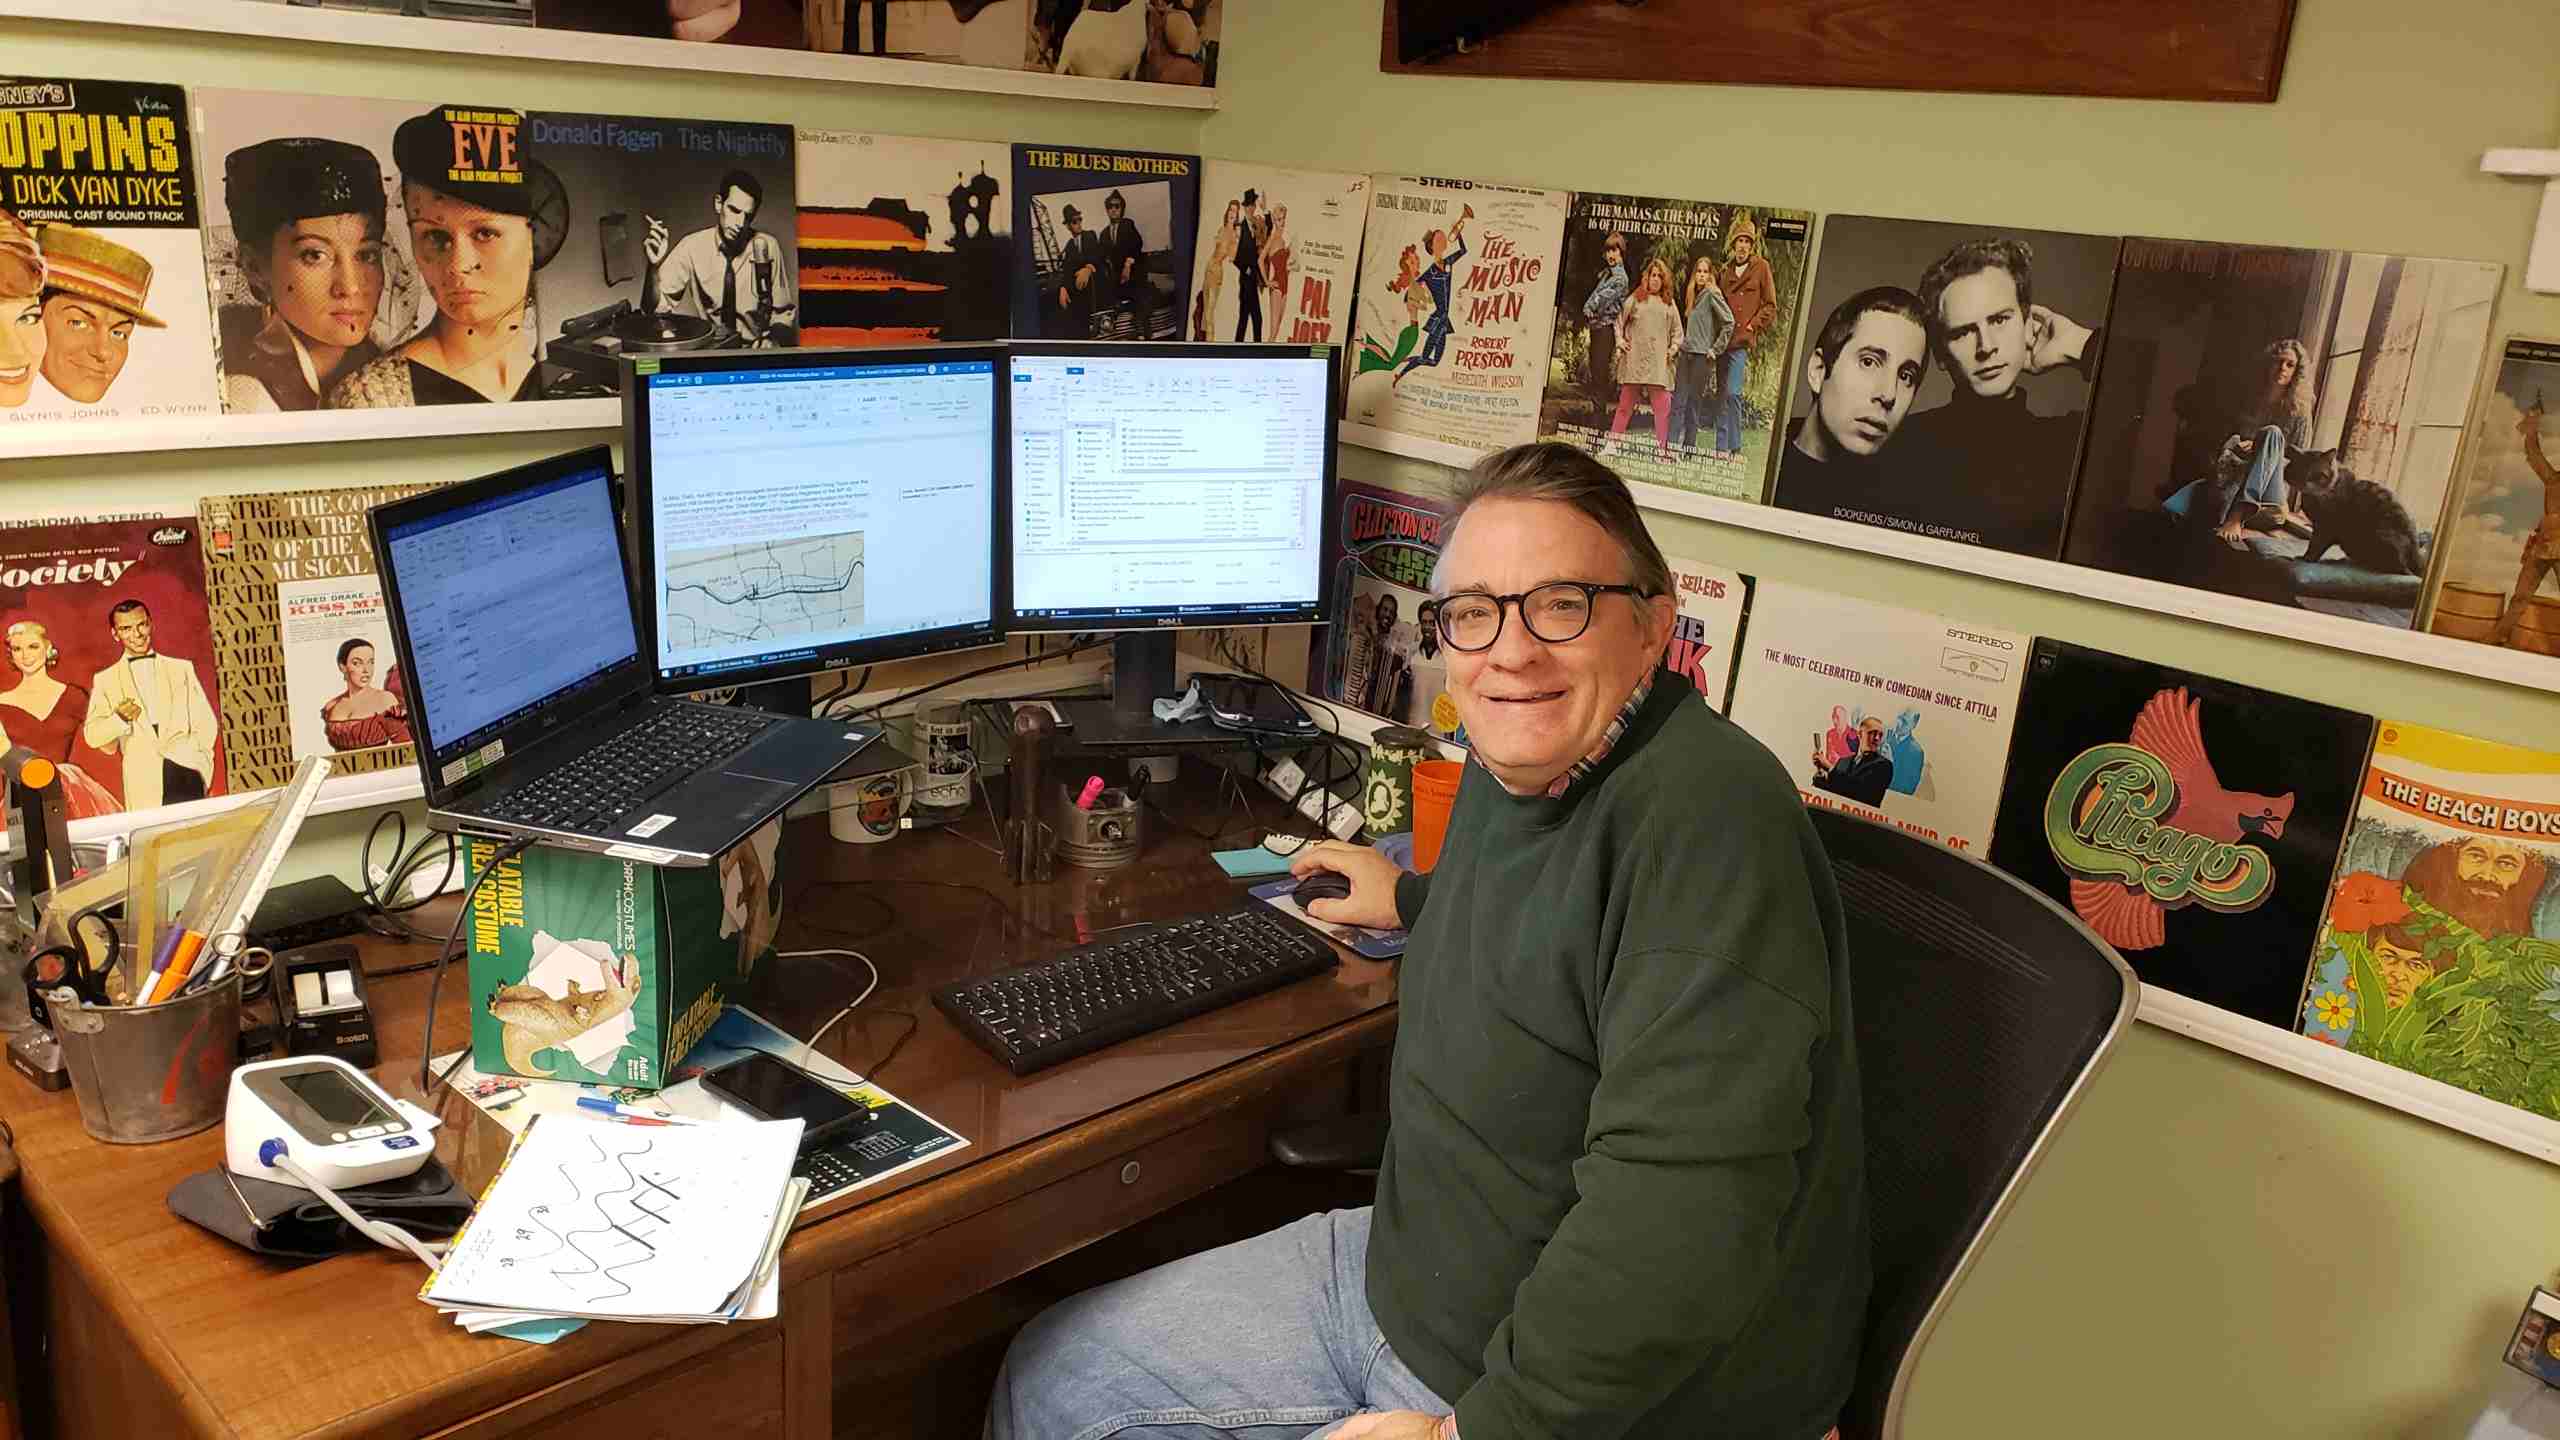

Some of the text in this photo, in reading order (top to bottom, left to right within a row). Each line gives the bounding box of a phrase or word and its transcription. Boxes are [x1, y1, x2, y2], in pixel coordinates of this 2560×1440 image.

[450, 122, 519, 170] EVE
[532, 119, 787, 158] Donald Fagen The Nightfly
[1025, 150, 1190, 176] THE BLUES BROTHERS
[13, 175, 183, 207] DICK VAN DYKE
[1419, 176, 1473, 191] STEREO
[18, 208, 185, 221] ORIGINAL CAST SOUND TRACK
[1591, 203, 1721, 228] THE MAMAS & THE PAPAS
[1588, 216, 1719, 242] 16 OF THEIR GREATEST HITS
[1480, 230, 1515, 260] THE
[1457, 254, 1545, 298] MUSIC
[1300, 276, 1332, 319] PAL
[1462, 291, 1525, 329] MAN
[1470, 335, 1511, 351] ROBERT
[1454, 349, 1515, 371] PRESTON
[70, 407, 120, 419] JOHNS
[97, 511, 164, 524] STEREO
[284, 495, 332, 517] THE
[1352, 503, 1418, 540] CLIFTON
[1926, 524, 1982, 545] GARFUNKEL
[273, 538, 304, 560] OF
[306, 535, 353, 558] THE
[272, 555, 368, 580] MUSICAL
[288, 592, 365, 605] ALFRED DRAKE
[1680, 573, 1727, 599] SELLERS
[288, 603, 345, 616] KISS
[1946, 627, 2014, 651] STEREO
[824, 657, 851, 669] DELL
[1765, 648, 1998, 720] THE MOST CELEBRATED NEW COMEDIAN SINCE ATTILA
[2382, 776, 2560, 836] THE BEACH BOYS
[2044, 742, 2271, 906] Chicago
[336, 1033, 369, 1045] Scotch
